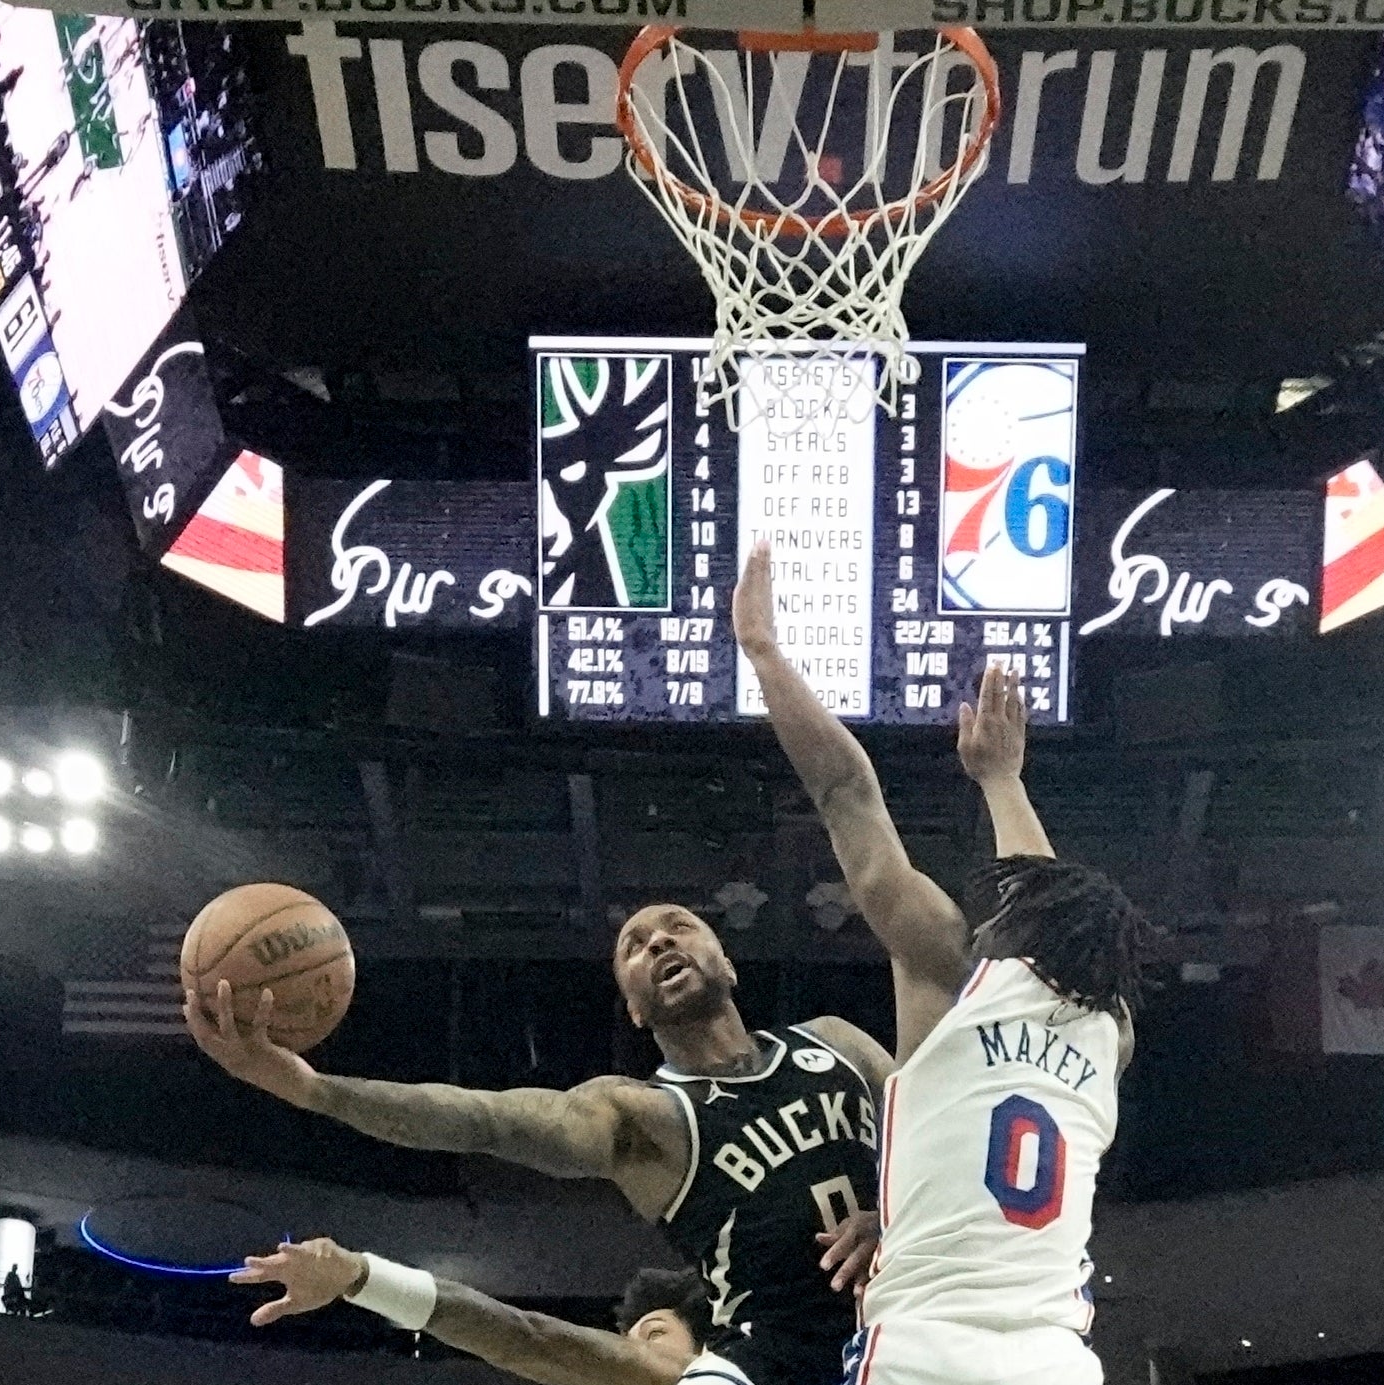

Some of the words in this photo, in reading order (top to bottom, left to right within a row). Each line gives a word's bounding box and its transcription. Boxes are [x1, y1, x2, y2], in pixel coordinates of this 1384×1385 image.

[286, 19, 829, 183] fiserv
[862, 28, 1307, 184] forum
[764, 366, 852, 387] ASSISTS
[767, 399, 849, 419] BLOCKS
[901, 394, 915, 419] 3
[695, 423, 710, 448] 4
[767, 432, 847, 452] STEALS
[901, 426, 915, 451] 3
[695, 456, 710, 480] 4
[764, 465, 802, 485] OFF
[812, 465, 849, 485] REB
[900, 458, 914, 483] 3
[692, 488, 715, 512] 14
[765, 497, 799, 517] DEF
[811, 497, 848, 518] REB
[897, 490, 920, 515] 13
[692, 521, 715, 546] 10
[751, 529, 863, 550] TURNOVERS
[900, 524, 914, 549] 8
[695, 553, 709, 578] 6
[770, 562, 814, 582] OTAL
[823, 562, 858, 582] FLS
[899, 556, 913, 580] 6
[691, 586, 715, 610] 14
[778, 594, 814, 613] NCH
[822, 594, 857, 613] PTS
[891, 588, 919, 612] 24
[568, 616, 624, 641] 51.4%
[660, 617, 714, 642] 19/37
[804, 626, 864, 646] GOALS
[894, 620, 955, 645] 22/39
[983, 621, 1027, 646] 56.4
[1033, 623, 1052, 647] %
[568, 648, 624, 673] 42.1%
[667, 649, 710, 674] 8/19
[797, 658, 859, 678] NTERS
[906, 652, 949, 676] 11/19
[1031, 655, 1051, 678] %
[567, 680, 624, 705] 77.8%
[666, 681, 704, 705] 7/9
[905, 684, 942, 708] 6/8
[976, 1020, 1097, 1092] MAXEY
[713, 1091, 878, 1193] BUCKS
[985, 1093, 1066, 1230] 0
